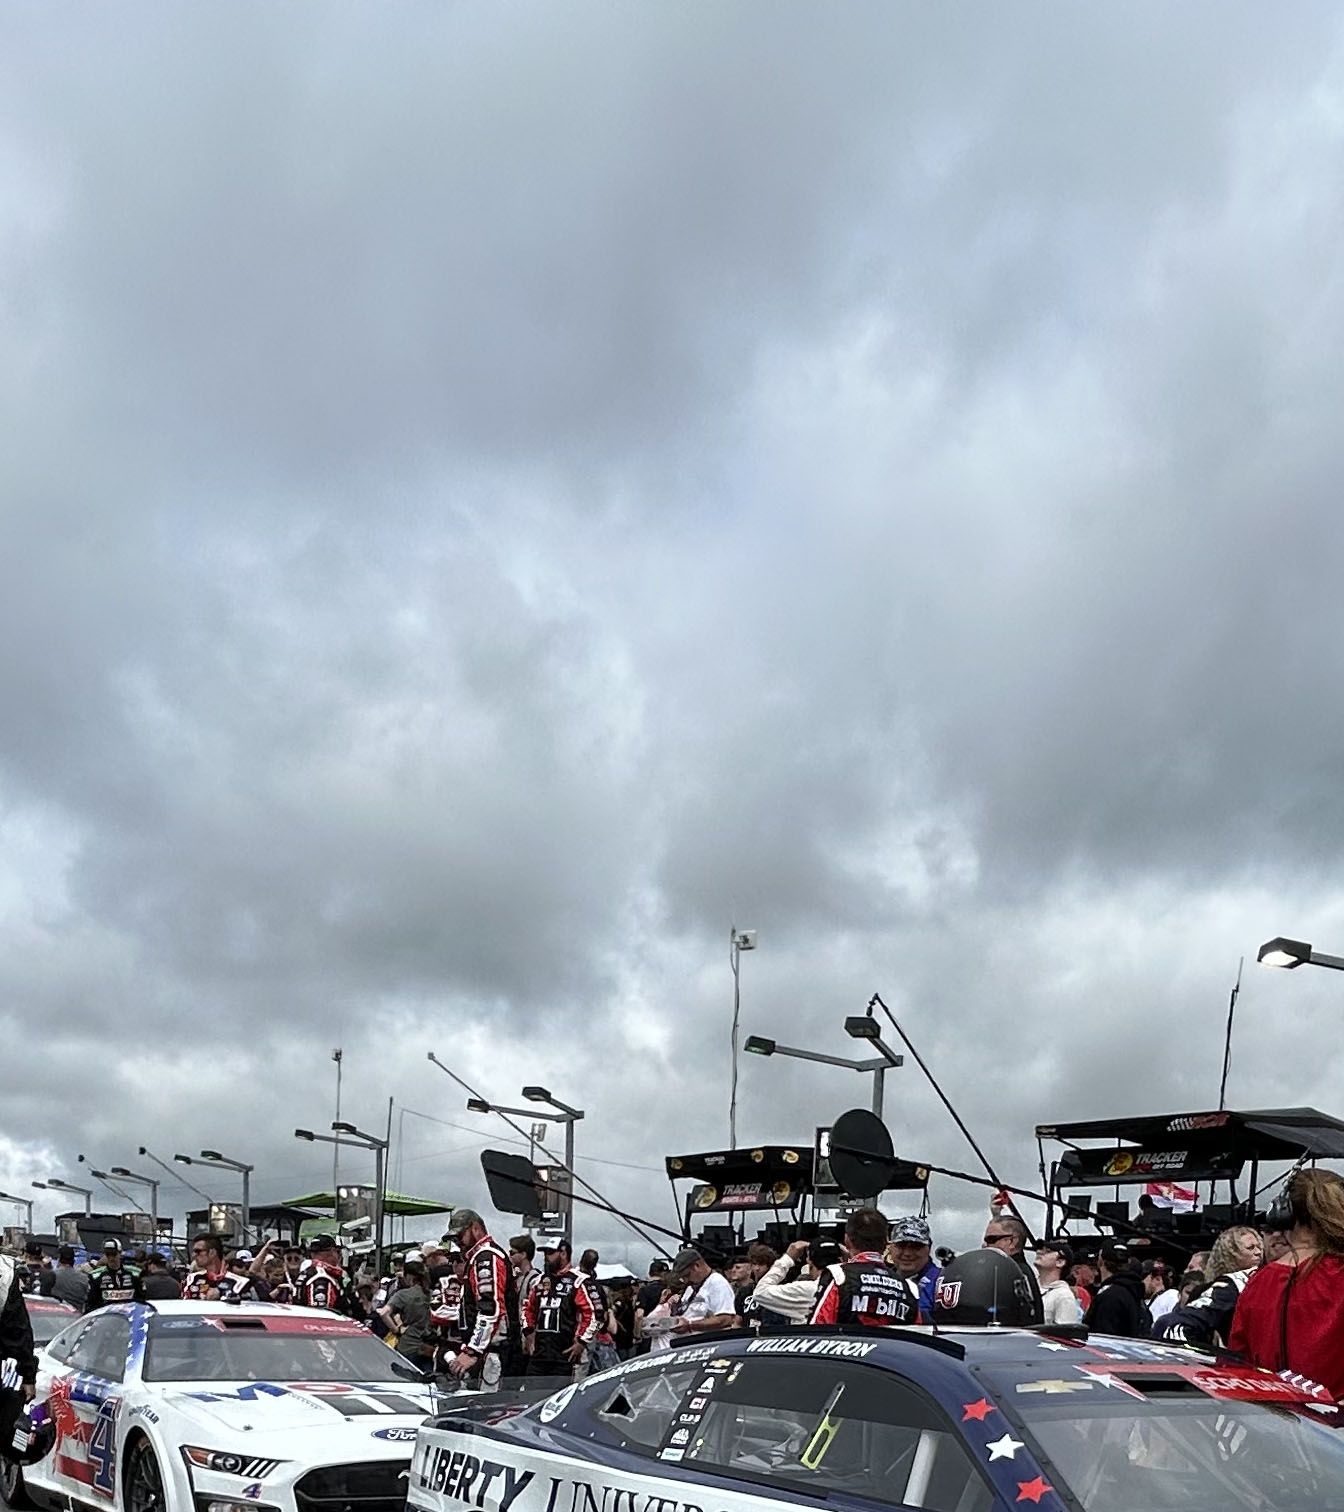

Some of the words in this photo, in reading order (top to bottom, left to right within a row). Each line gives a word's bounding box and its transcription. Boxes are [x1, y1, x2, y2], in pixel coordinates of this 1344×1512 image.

[1136, 1151, 1188, 1165] TRACKER
[746, 1339, 815, 1353] WILLIAM
[810, 1340, 878, 1358] BYRON
[88, 1396, 123, 1499] 4
